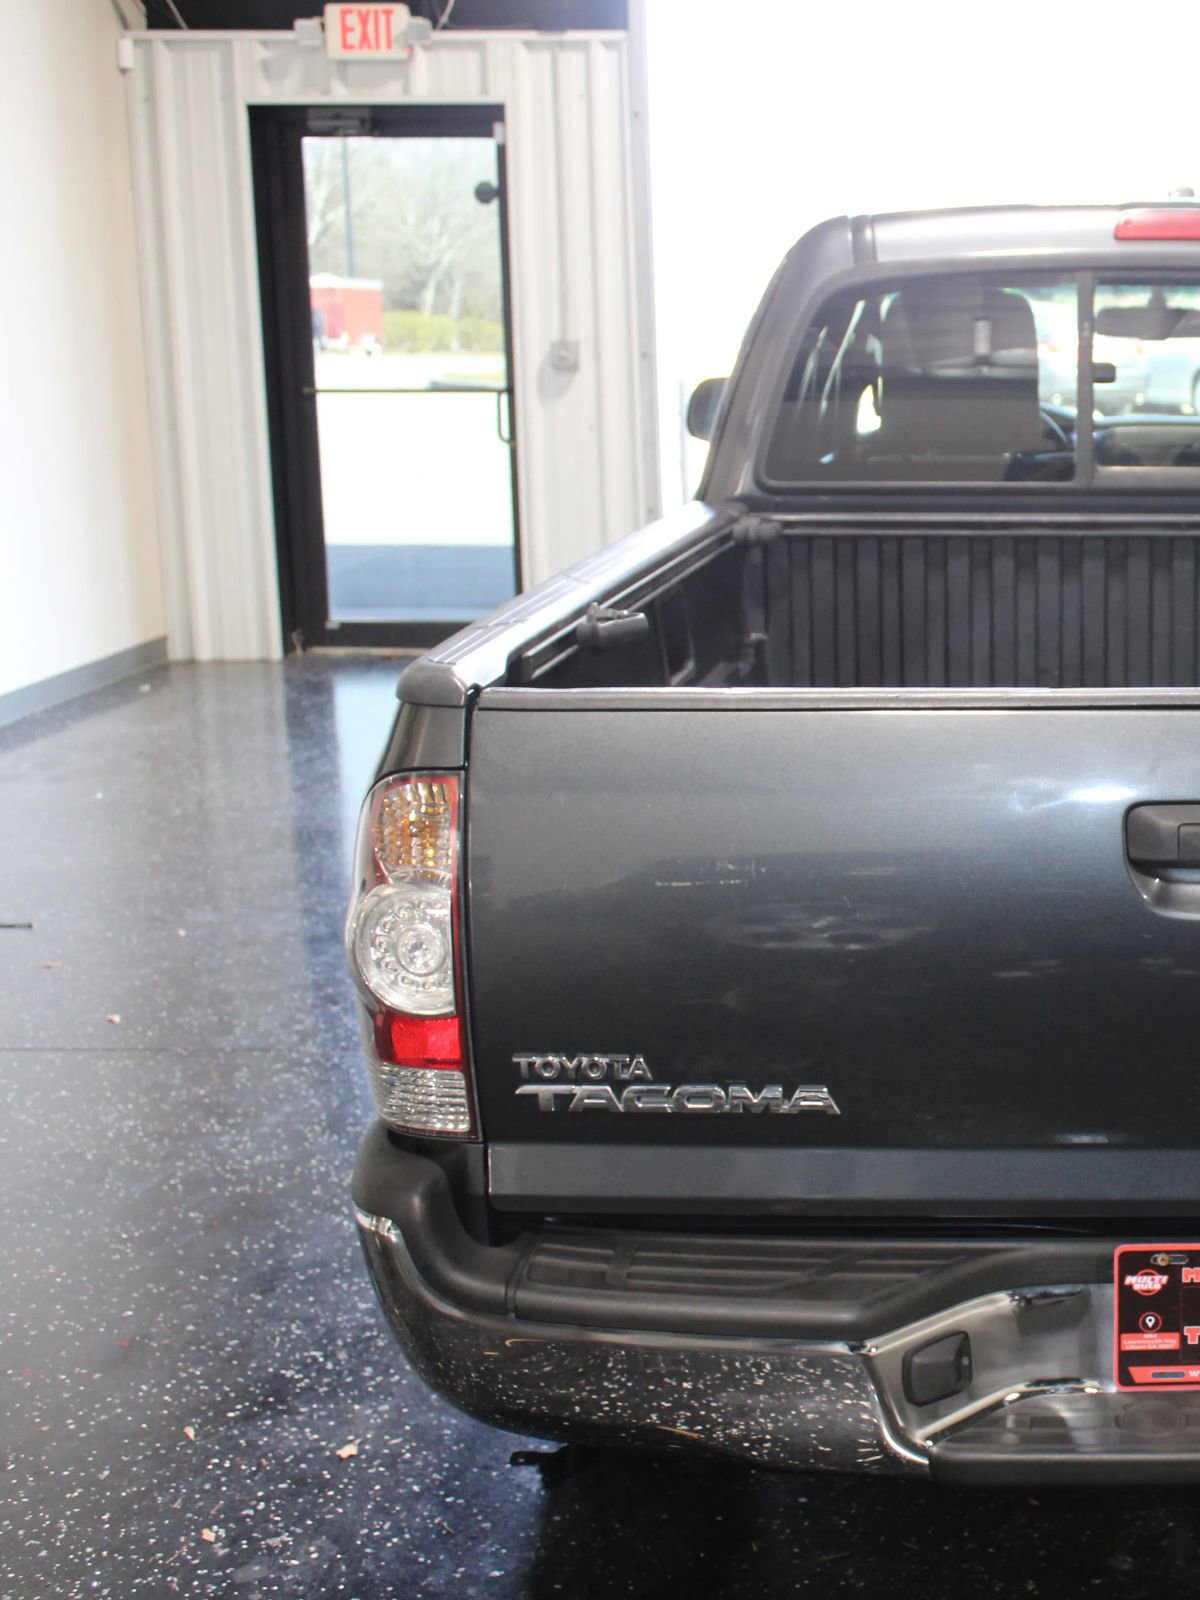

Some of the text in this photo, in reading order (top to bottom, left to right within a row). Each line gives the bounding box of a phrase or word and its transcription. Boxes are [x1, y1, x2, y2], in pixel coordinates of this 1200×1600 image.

[339, 9, 394, 51] EXIT
[512, 1053, 653, 1080] TOYOTA
[514, 1085, 841, 1114] TACOMA
[1124, 1275, 1169, 1285] MULTI
